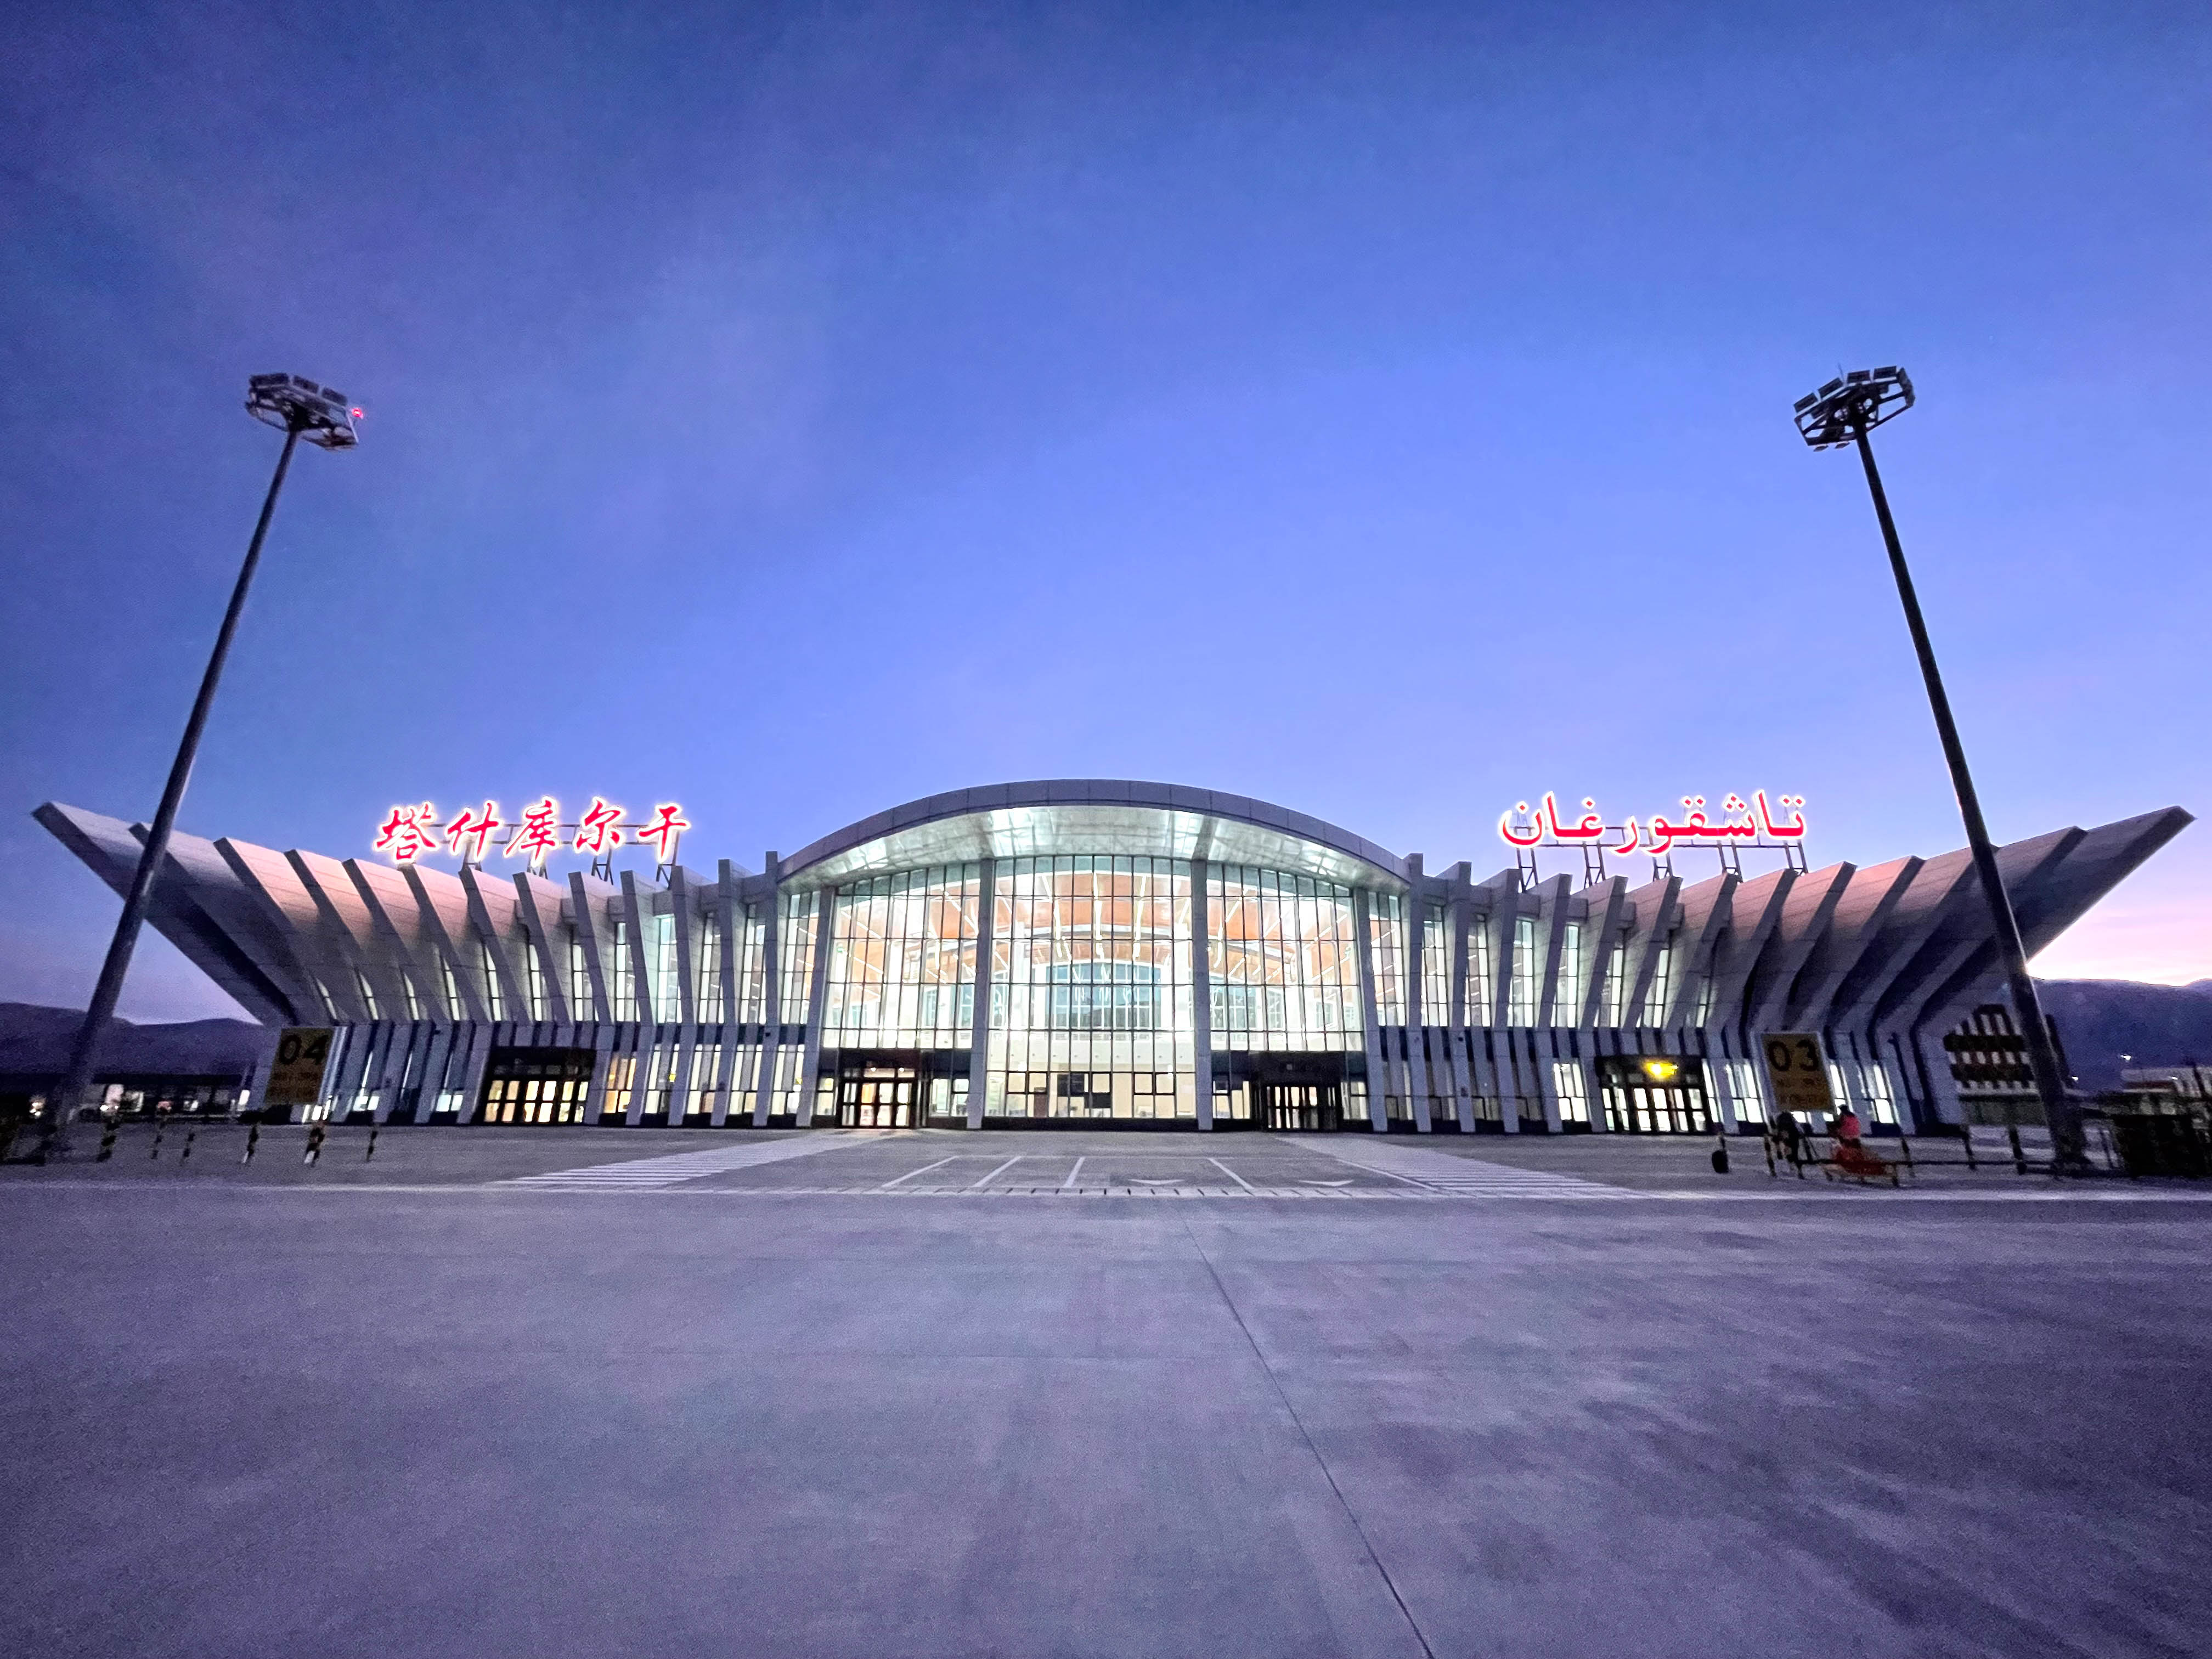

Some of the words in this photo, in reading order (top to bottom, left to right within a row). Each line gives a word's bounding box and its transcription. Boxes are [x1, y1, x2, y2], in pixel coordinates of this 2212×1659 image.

[375, 797, 691, 866] 塔什库尔干
[1500, 789, 1807, 856] تاشقورغان
[279, 1034, 329, 1065] 04
[1768, 1040, 1819, 1071] 03
